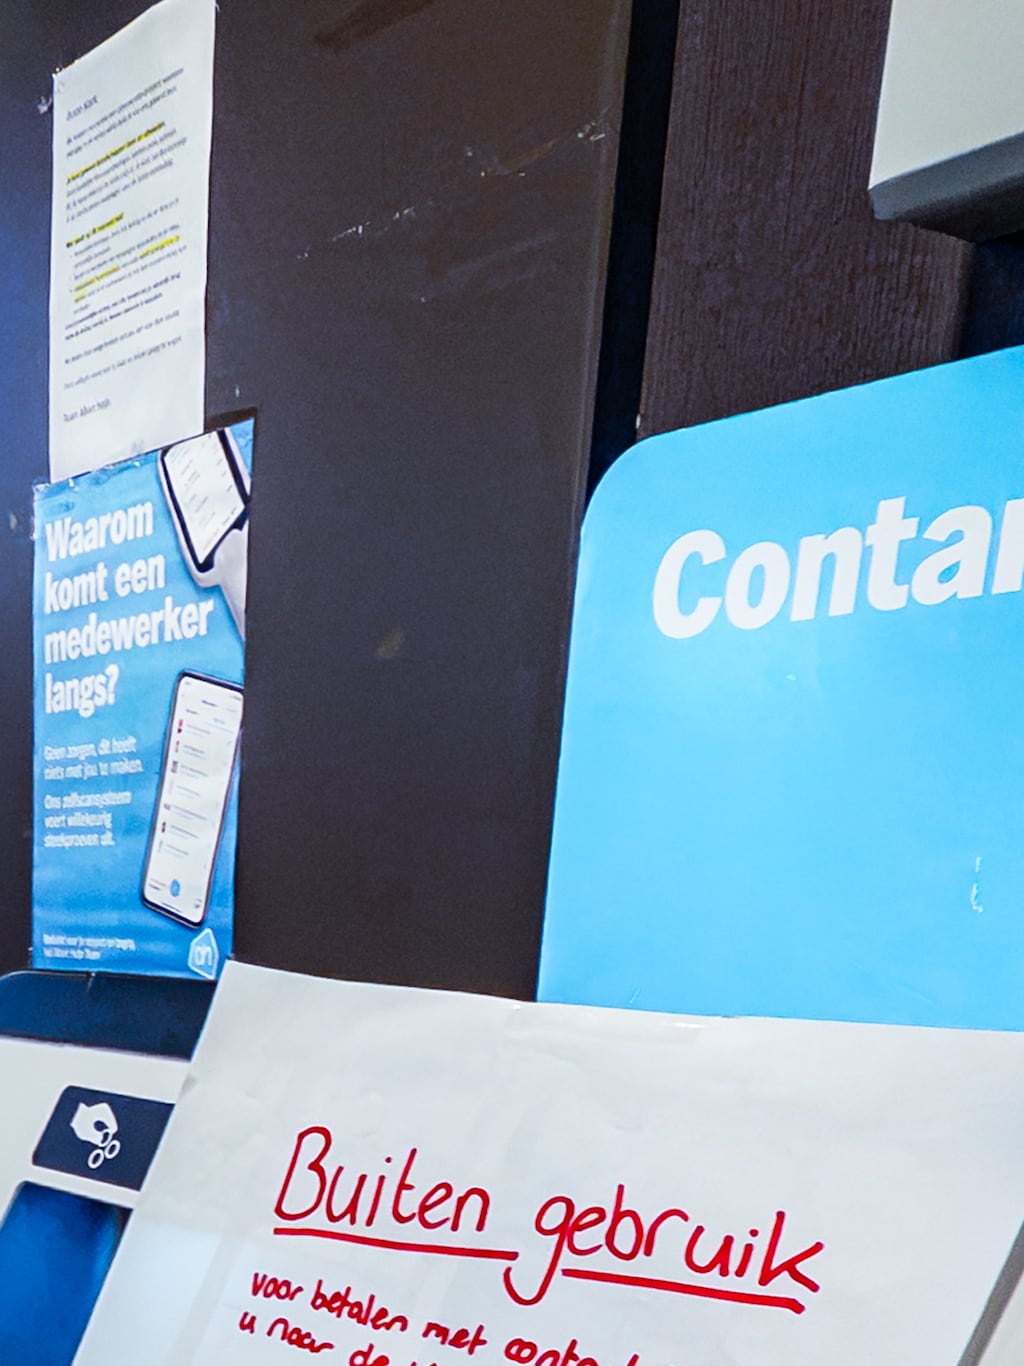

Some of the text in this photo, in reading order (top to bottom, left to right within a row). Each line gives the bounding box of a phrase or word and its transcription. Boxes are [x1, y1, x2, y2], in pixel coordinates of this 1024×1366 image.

[45, 501, 154, 562] Waarom
[44, 554, 166, 615] komt een
[44, 597, 215, 665] medewerker
[44, 664, 120, 719] langs?
[274, 1126, 825, 1306] Buiten gebruik
[238, 1311, 258, 1334] u
[266, 1317, 335, 1354] naar
[250, 1272, 304, 1300] voor
[311, 1279, 409, 1332] betalen
[422, 1321, 488, 1355] met
